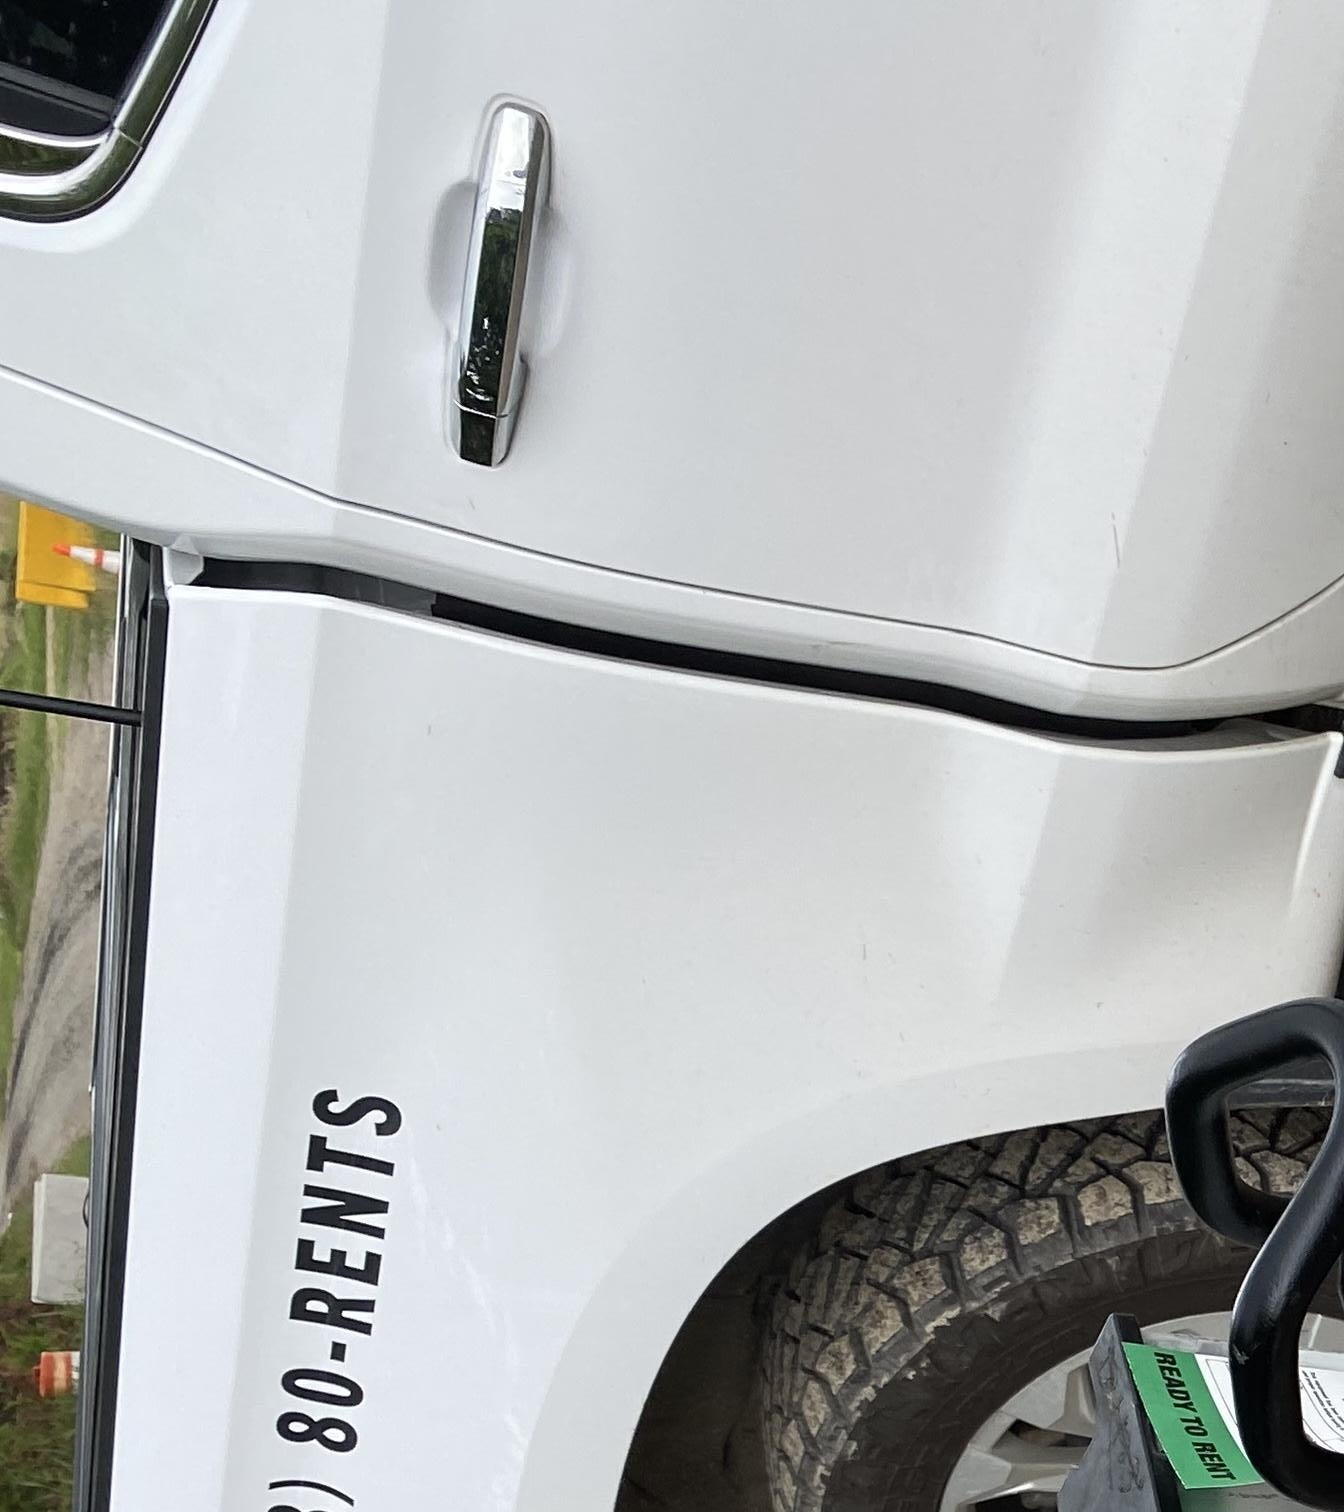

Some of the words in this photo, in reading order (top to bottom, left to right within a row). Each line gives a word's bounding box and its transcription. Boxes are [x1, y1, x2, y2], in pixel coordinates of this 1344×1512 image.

[276, 1089, 402, 1452] 80-RENTS
[1153, 1351, 1198, 1413] READY
[1179, 1415, 1209, 1437] TO
[1191, 1441, 1236, 1481] RENT
